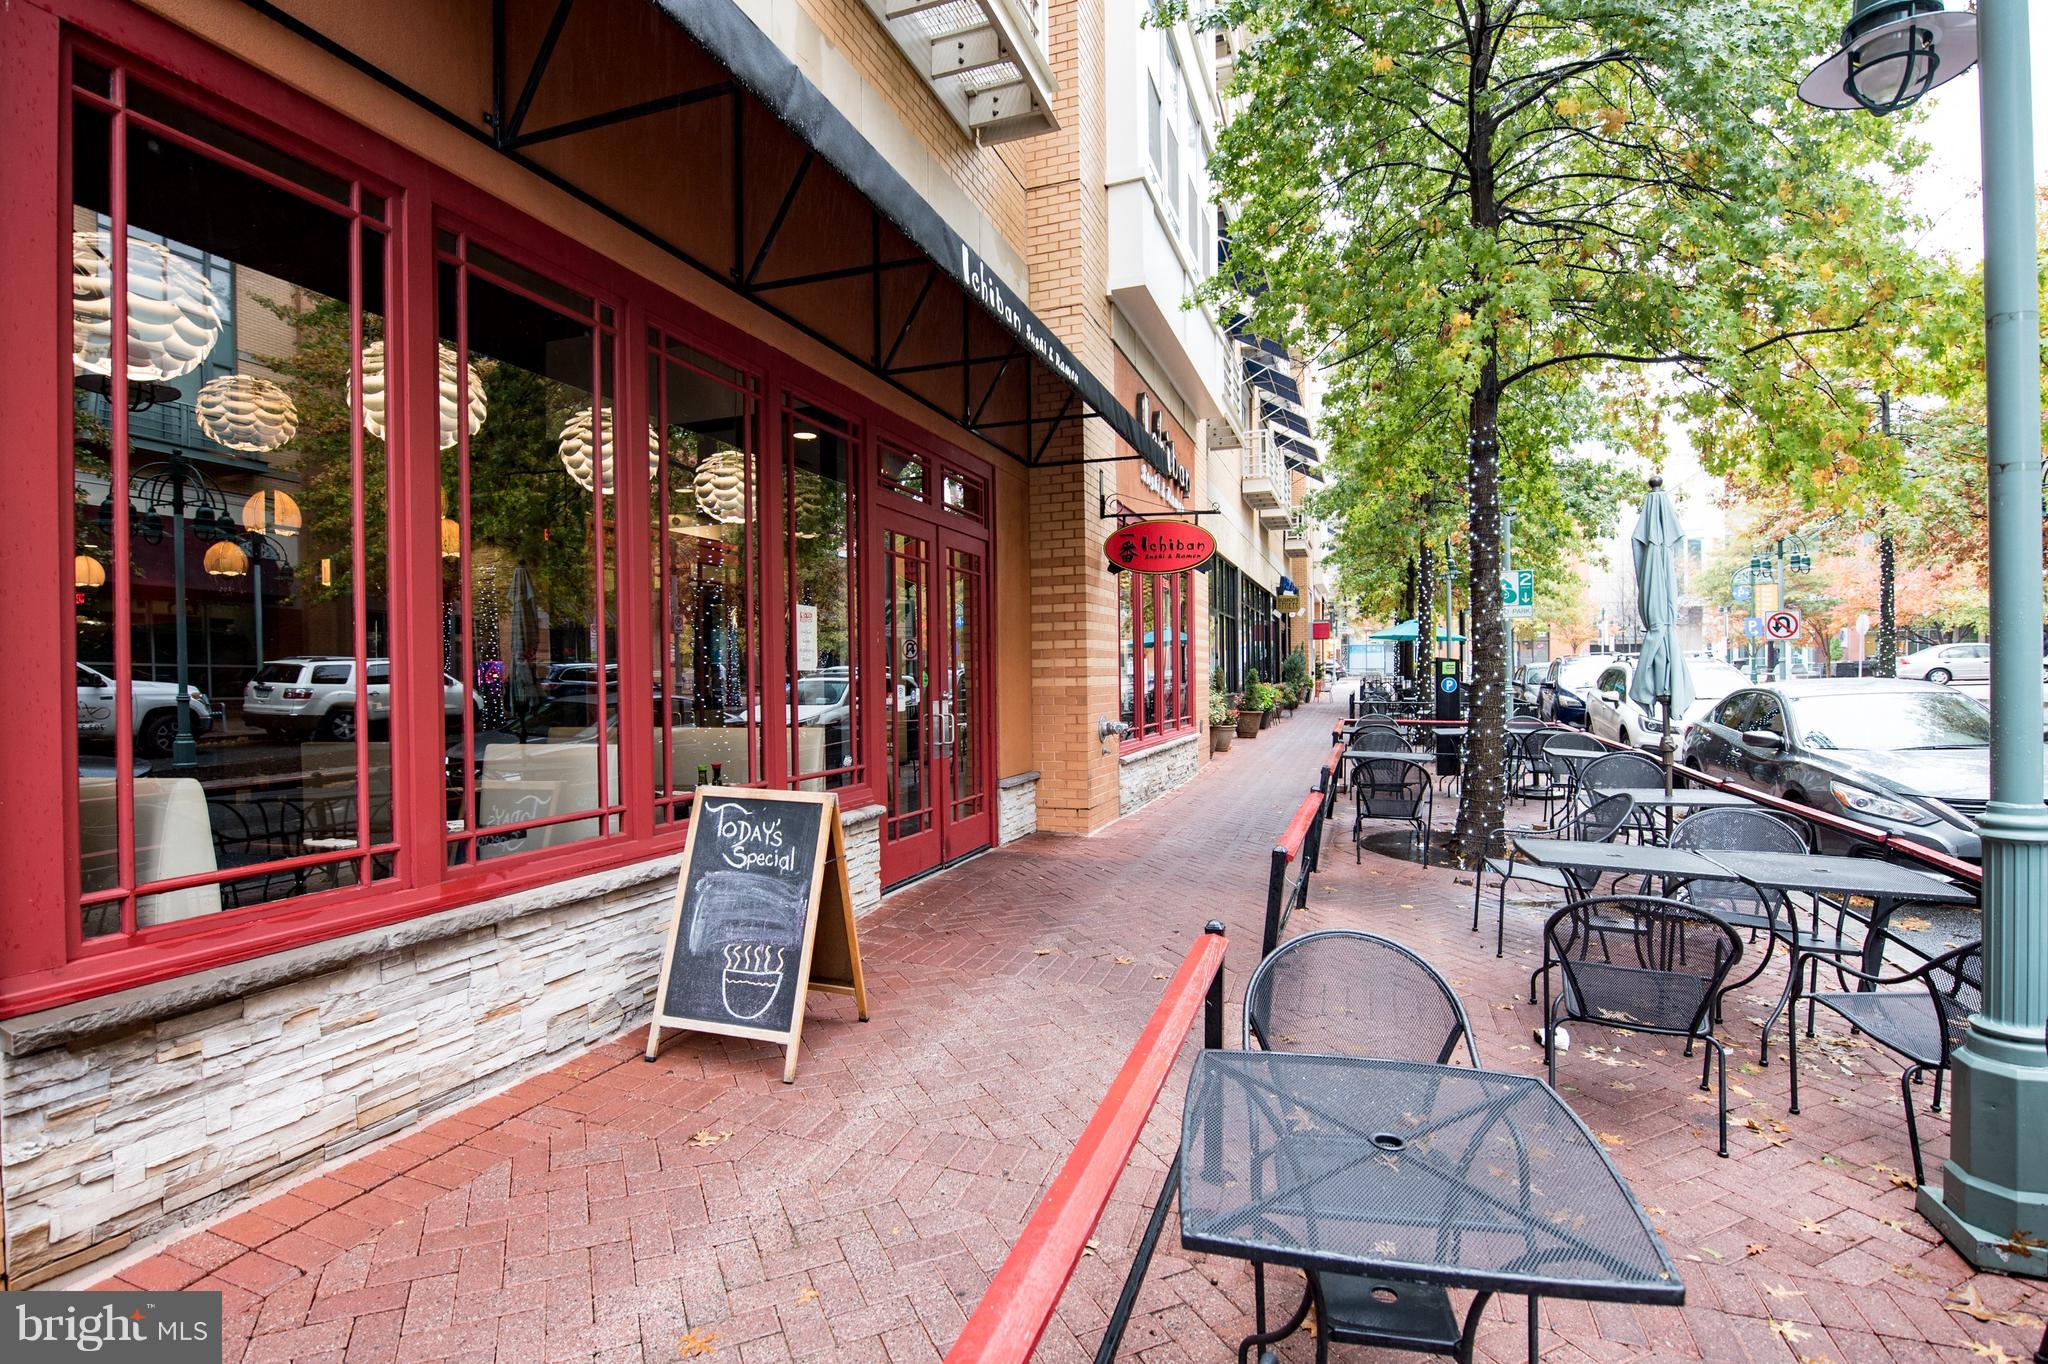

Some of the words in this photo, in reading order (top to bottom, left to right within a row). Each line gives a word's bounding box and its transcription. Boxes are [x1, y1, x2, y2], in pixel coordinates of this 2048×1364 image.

[961, 243, 1022, 333] Ichiban
[1025, 324, 1047, 356] Sushi
[1048, 346, 1054, 362] &
[1055, 352, 1079, 385] Ramen
[1141, 535, 1205, 552] Ichiban
[1519, 573, 1532, 586] 2
[1748, 620, 1757, 632] P
[1446, 680, 1454, 691] P
[722, 840, 796, 874] Special
